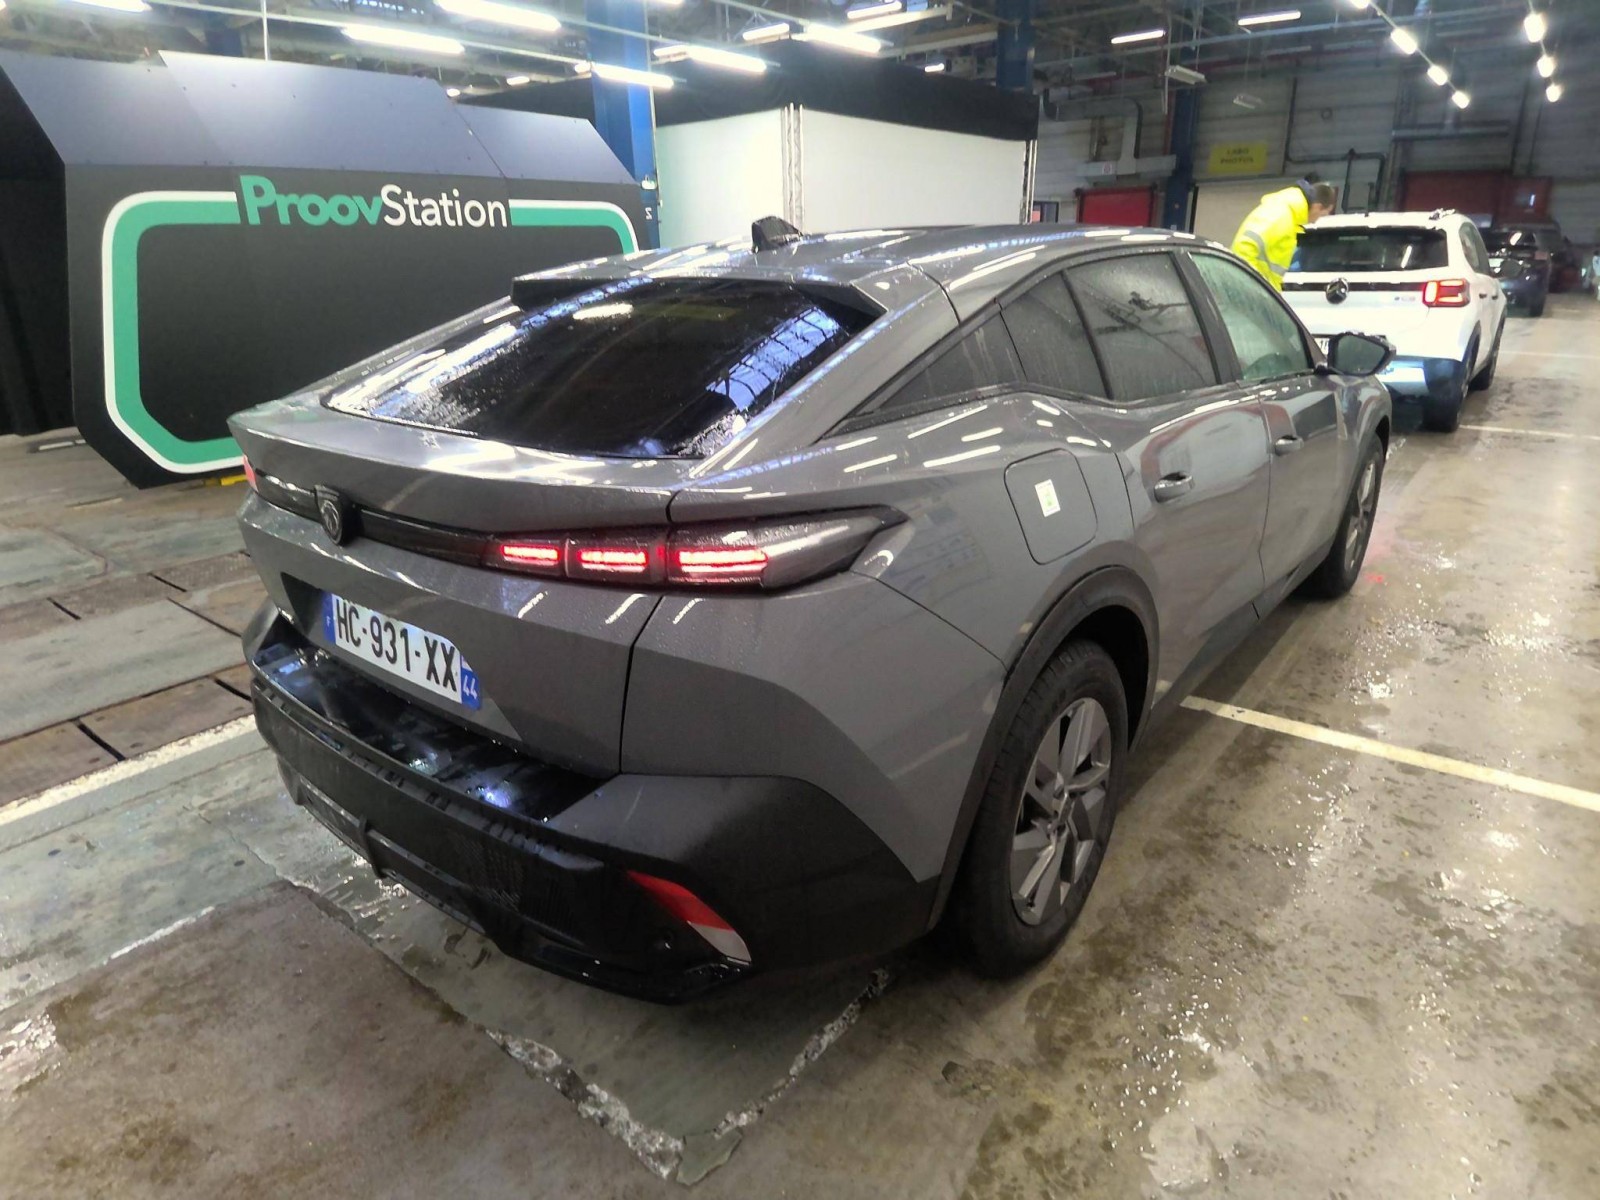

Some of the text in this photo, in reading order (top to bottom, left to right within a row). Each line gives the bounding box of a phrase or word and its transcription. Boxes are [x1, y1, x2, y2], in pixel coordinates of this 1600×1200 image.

[240, 174, 508, 228] ProovStation
[336, 598, 458, 692] HC-931-XX
[462, 674, 478, 700] 44
